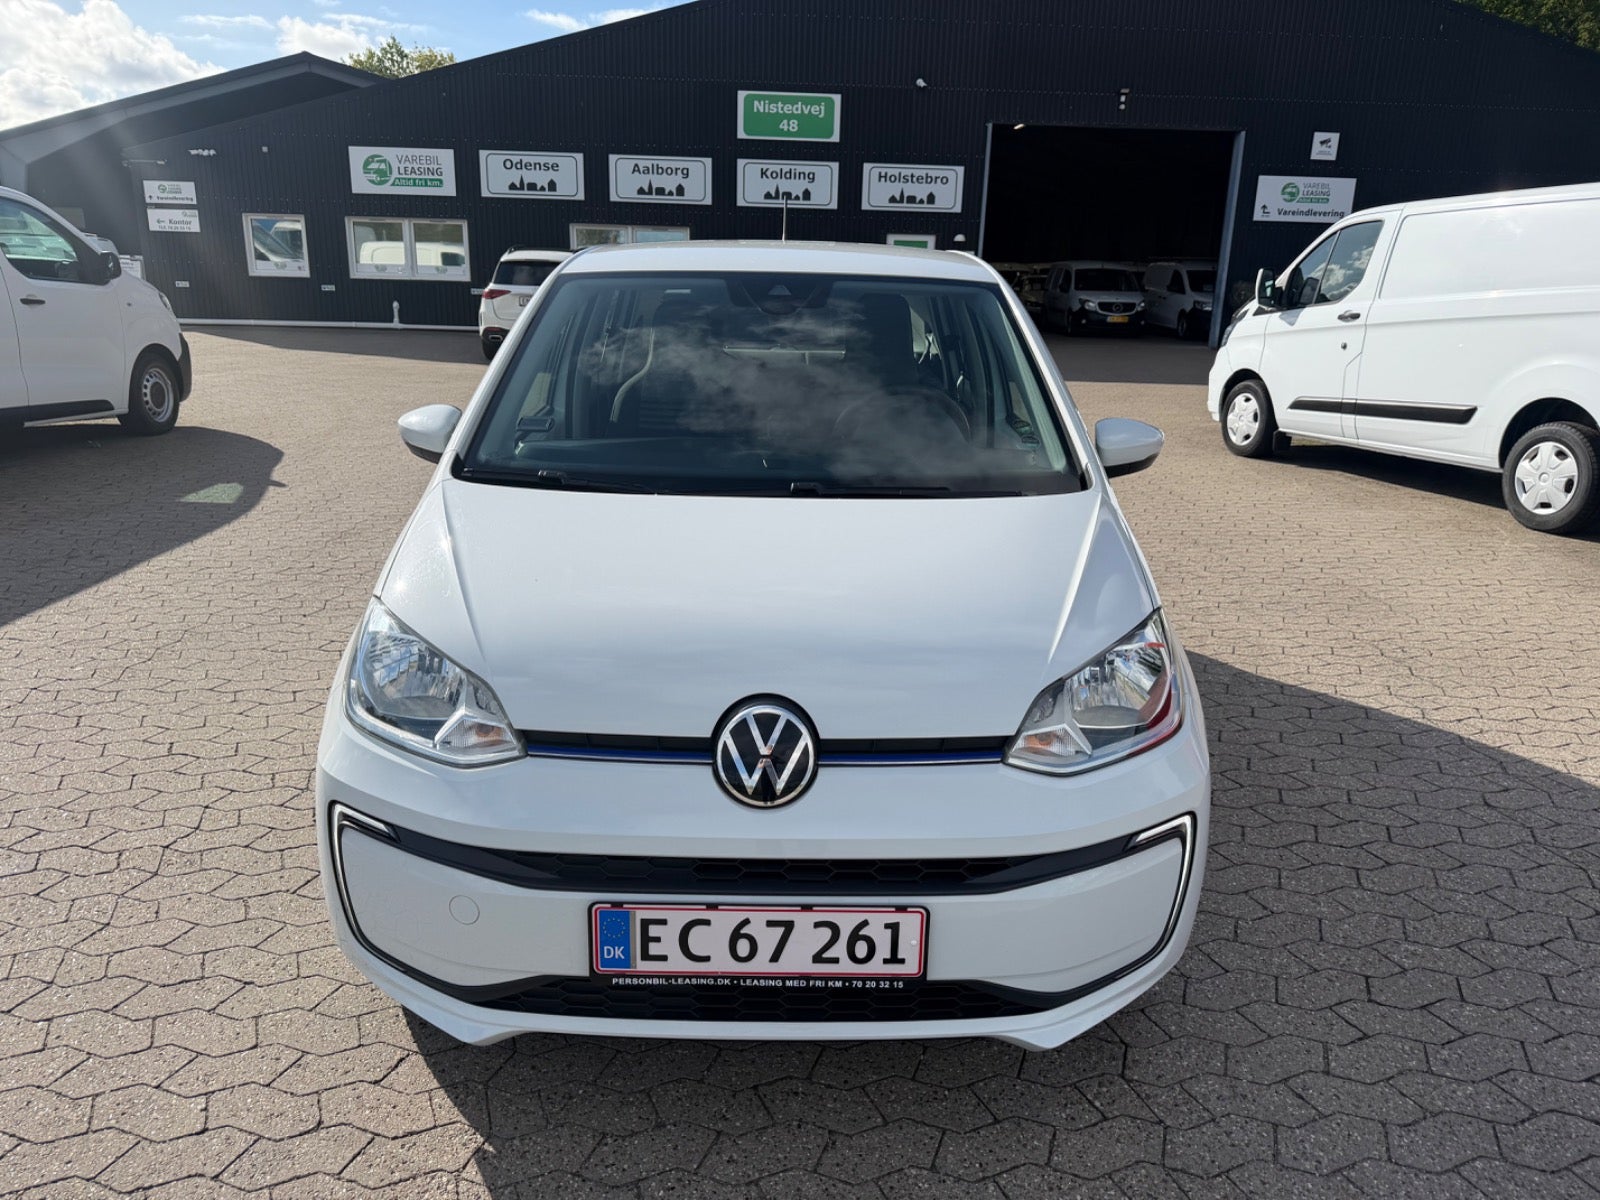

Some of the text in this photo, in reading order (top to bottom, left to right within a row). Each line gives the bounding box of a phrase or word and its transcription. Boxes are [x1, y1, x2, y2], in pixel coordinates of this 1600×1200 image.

[753, 100, 826, 118] Nistedvej
[779, 119, 799, 132] 48
[396, 154, 442, 166] VAREBIL
[502, 158, 560, 172] Odense
[397, 166, 444, 177] LEASING
[631, 163, 690, 179] Aalborg
[760, 167, 816, 183] Kolding
[877, 171, 949, 185] Holstebro
[1277, 207, 1345, 219] Vareindlevering
[168, 218, 192, 226] Kontor
[640, 917, 906, 965] EC 67 261
[603, 945, 625, 960] DK
[740, 978, 783, 987] LEASING
[785, 979, 807, 987] MED
[809, 979, 825, 988] FRI
[828, 980, 843, 988] KM
[852, 980, 863, 988] 70
[865, 980, 876, 988] 20
[879, 980, 890, 989] 32
[893, 980, 904, 989] 15
